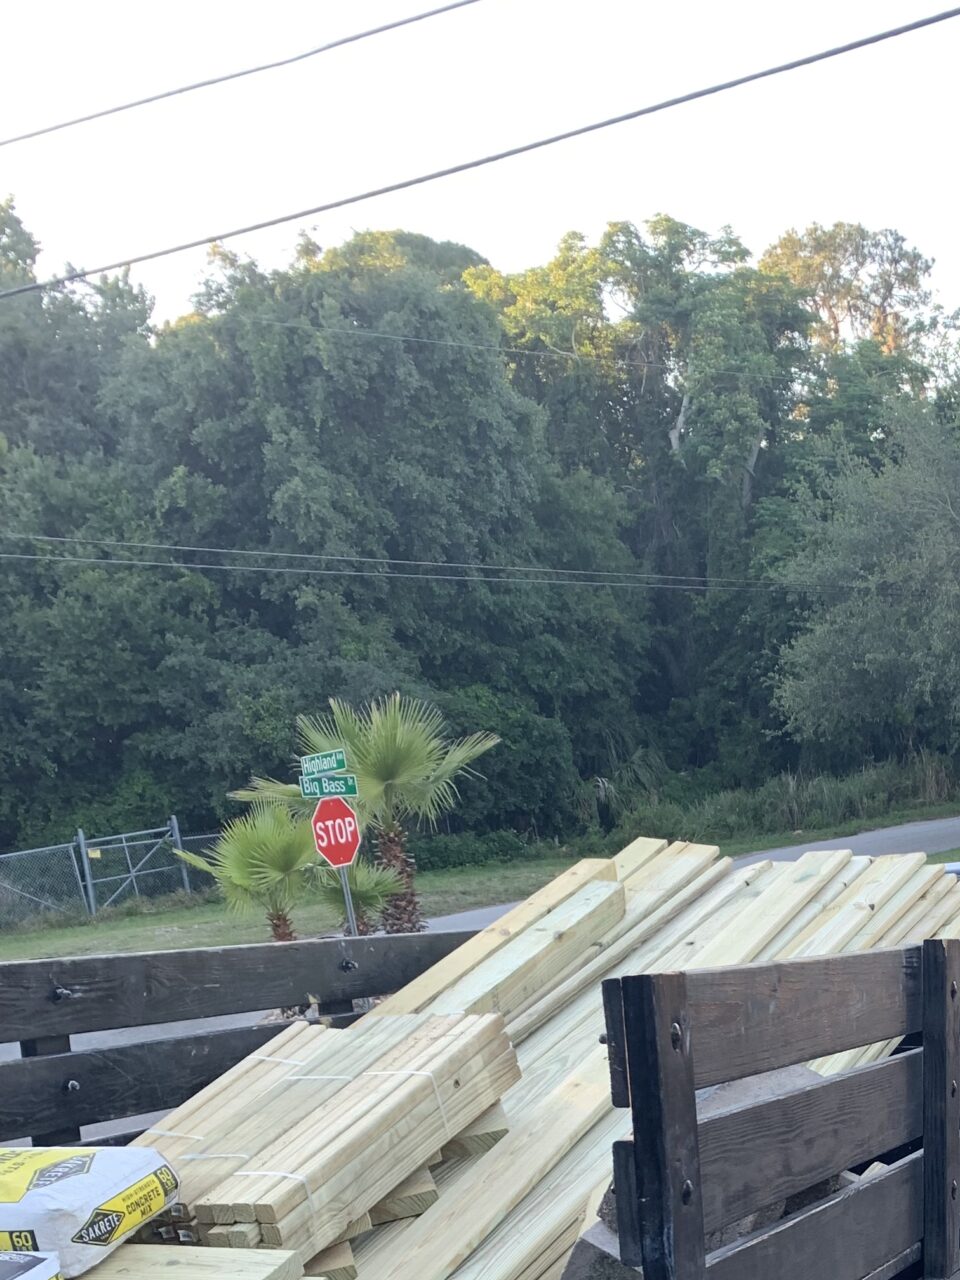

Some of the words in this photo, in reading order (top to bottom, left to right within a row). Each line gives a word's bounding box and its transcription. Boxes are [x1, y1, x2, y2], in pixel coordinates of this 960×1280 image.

[303, 752, 337, 775] Highland
[303, 778, 320, 796] Big
[322, 778, 346, 793] Bass
[316, 817, 356, 848] STOP
[157, 1167, 172, 1181] 60
[126, 1187, 161, 1215] CONCRETE
[140, 1204, 154, 1218] MIX
[81, 1213, 120, 1242] SAKRETE
[12, 1232, 32, 1247] 60
